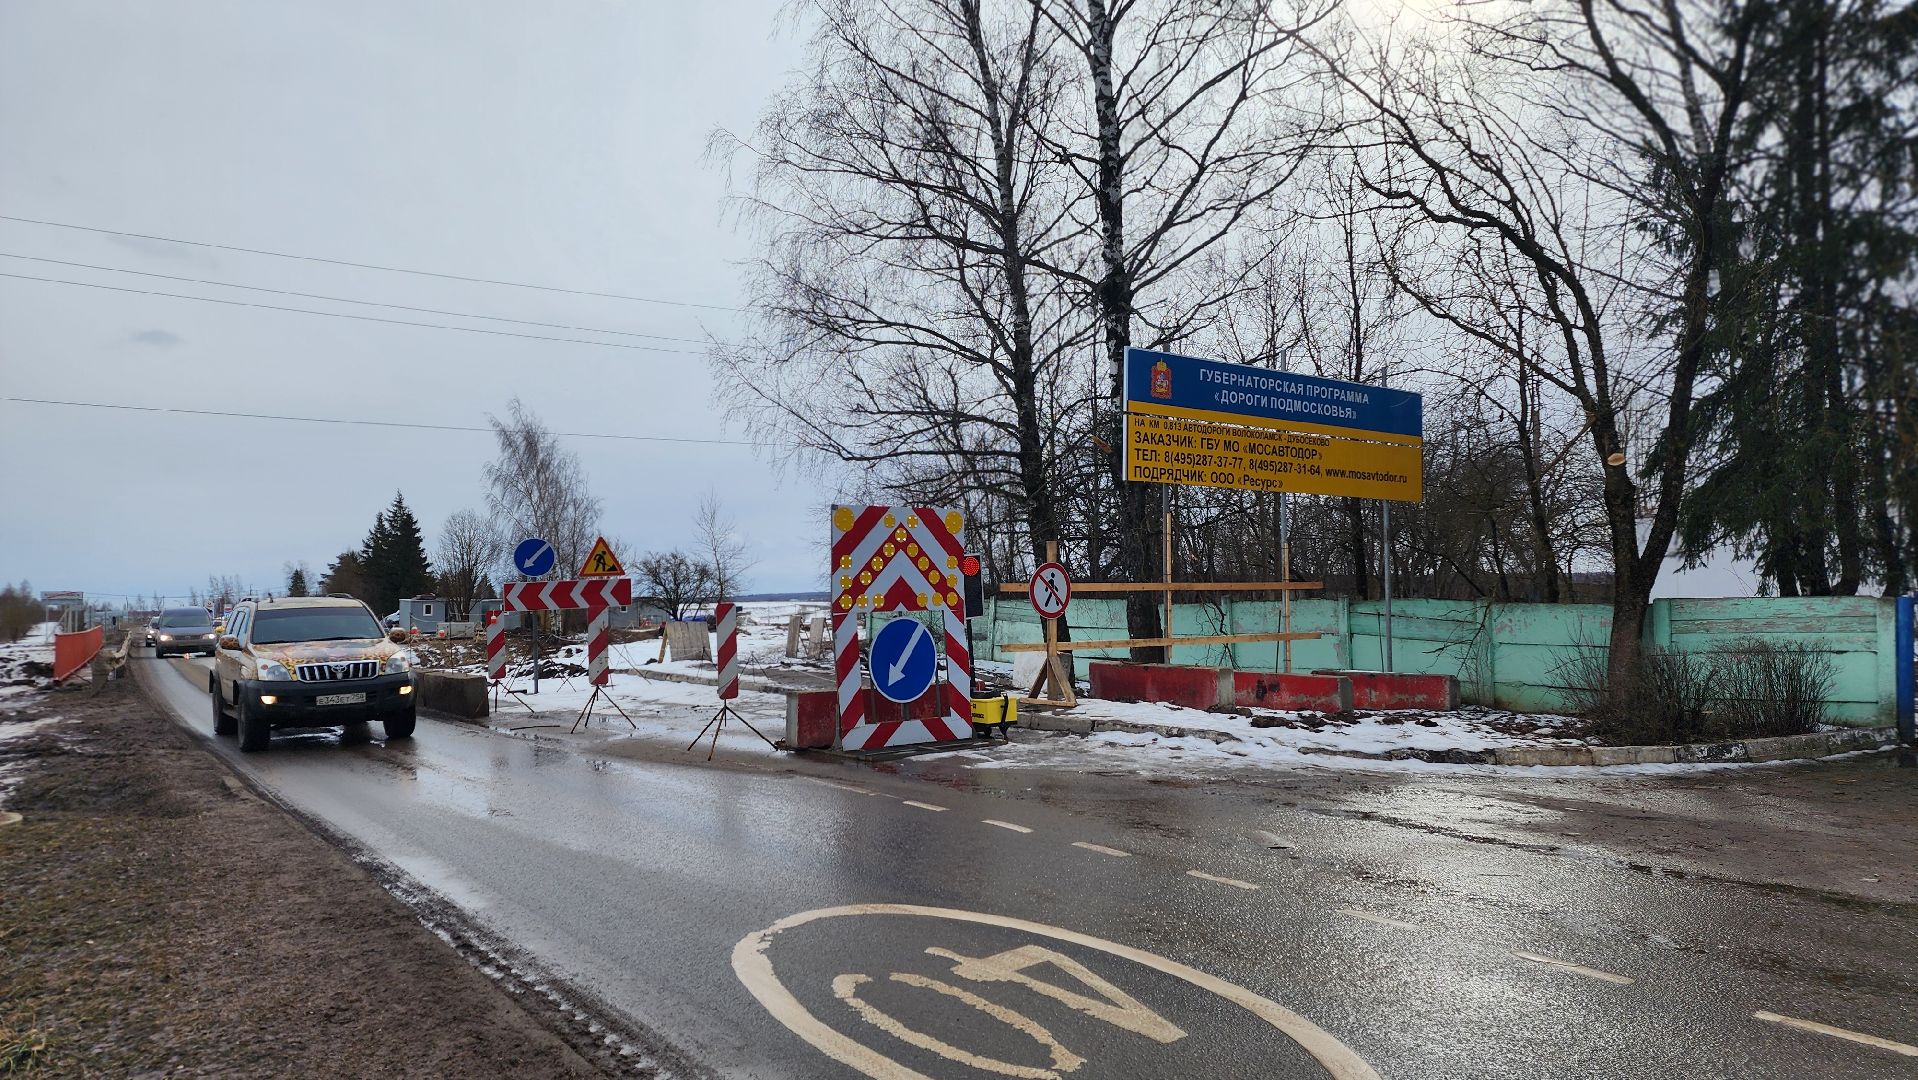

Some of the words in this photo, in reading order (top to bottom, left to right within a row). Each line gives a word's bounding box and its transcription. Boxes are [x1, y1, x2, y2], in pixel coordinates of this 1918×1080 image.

[1199, 368, 1304, 396] ГУБЕРНАТОРСКАЯ
[1306, 385, 1369, 405] ПРОГРАММА
[1214, 390, 1268, 409] «ДОРОГИ
[1270, 396, 1357, 420] ПОДМОСКОВЬЯ»
[1134, 418, 1145, 428] НА
[1149, 420, 1160, 429] КМ
[1163, 421, 1182, 431] 0,813
[1183, 423, 1231, 436] АВТОДОРОГИ
[1232, 428, 1283, 442] ВОЛОКОЛАМСК
[1286, 434, 1330, 447] ДУБОСЕКОВО
[1134, 431, 1197, 449] ЗАКАЗЧИК:
[1200, 437, 1221, 451] ГБУ
[1223, 440, 1240, 453] МО
[1242, 442, 1323, 461] «МОСАВТОДОР»
[1134, 448, 1161, 462] ТЕЛ:
[1164, 450, 1246, 470] 8(495)287-37-77,
[1249, 458, 1323, 477] 8(495)287-31-64,
[1325, 467, 1408, 484] www.mosavtodor.ru
[1134, 466, 1207, 483] ПОДРЯДЧИК:
[1210, 471, 1235, 484] ООО
[1237, 474, 1284, 490] «Ресурс»
